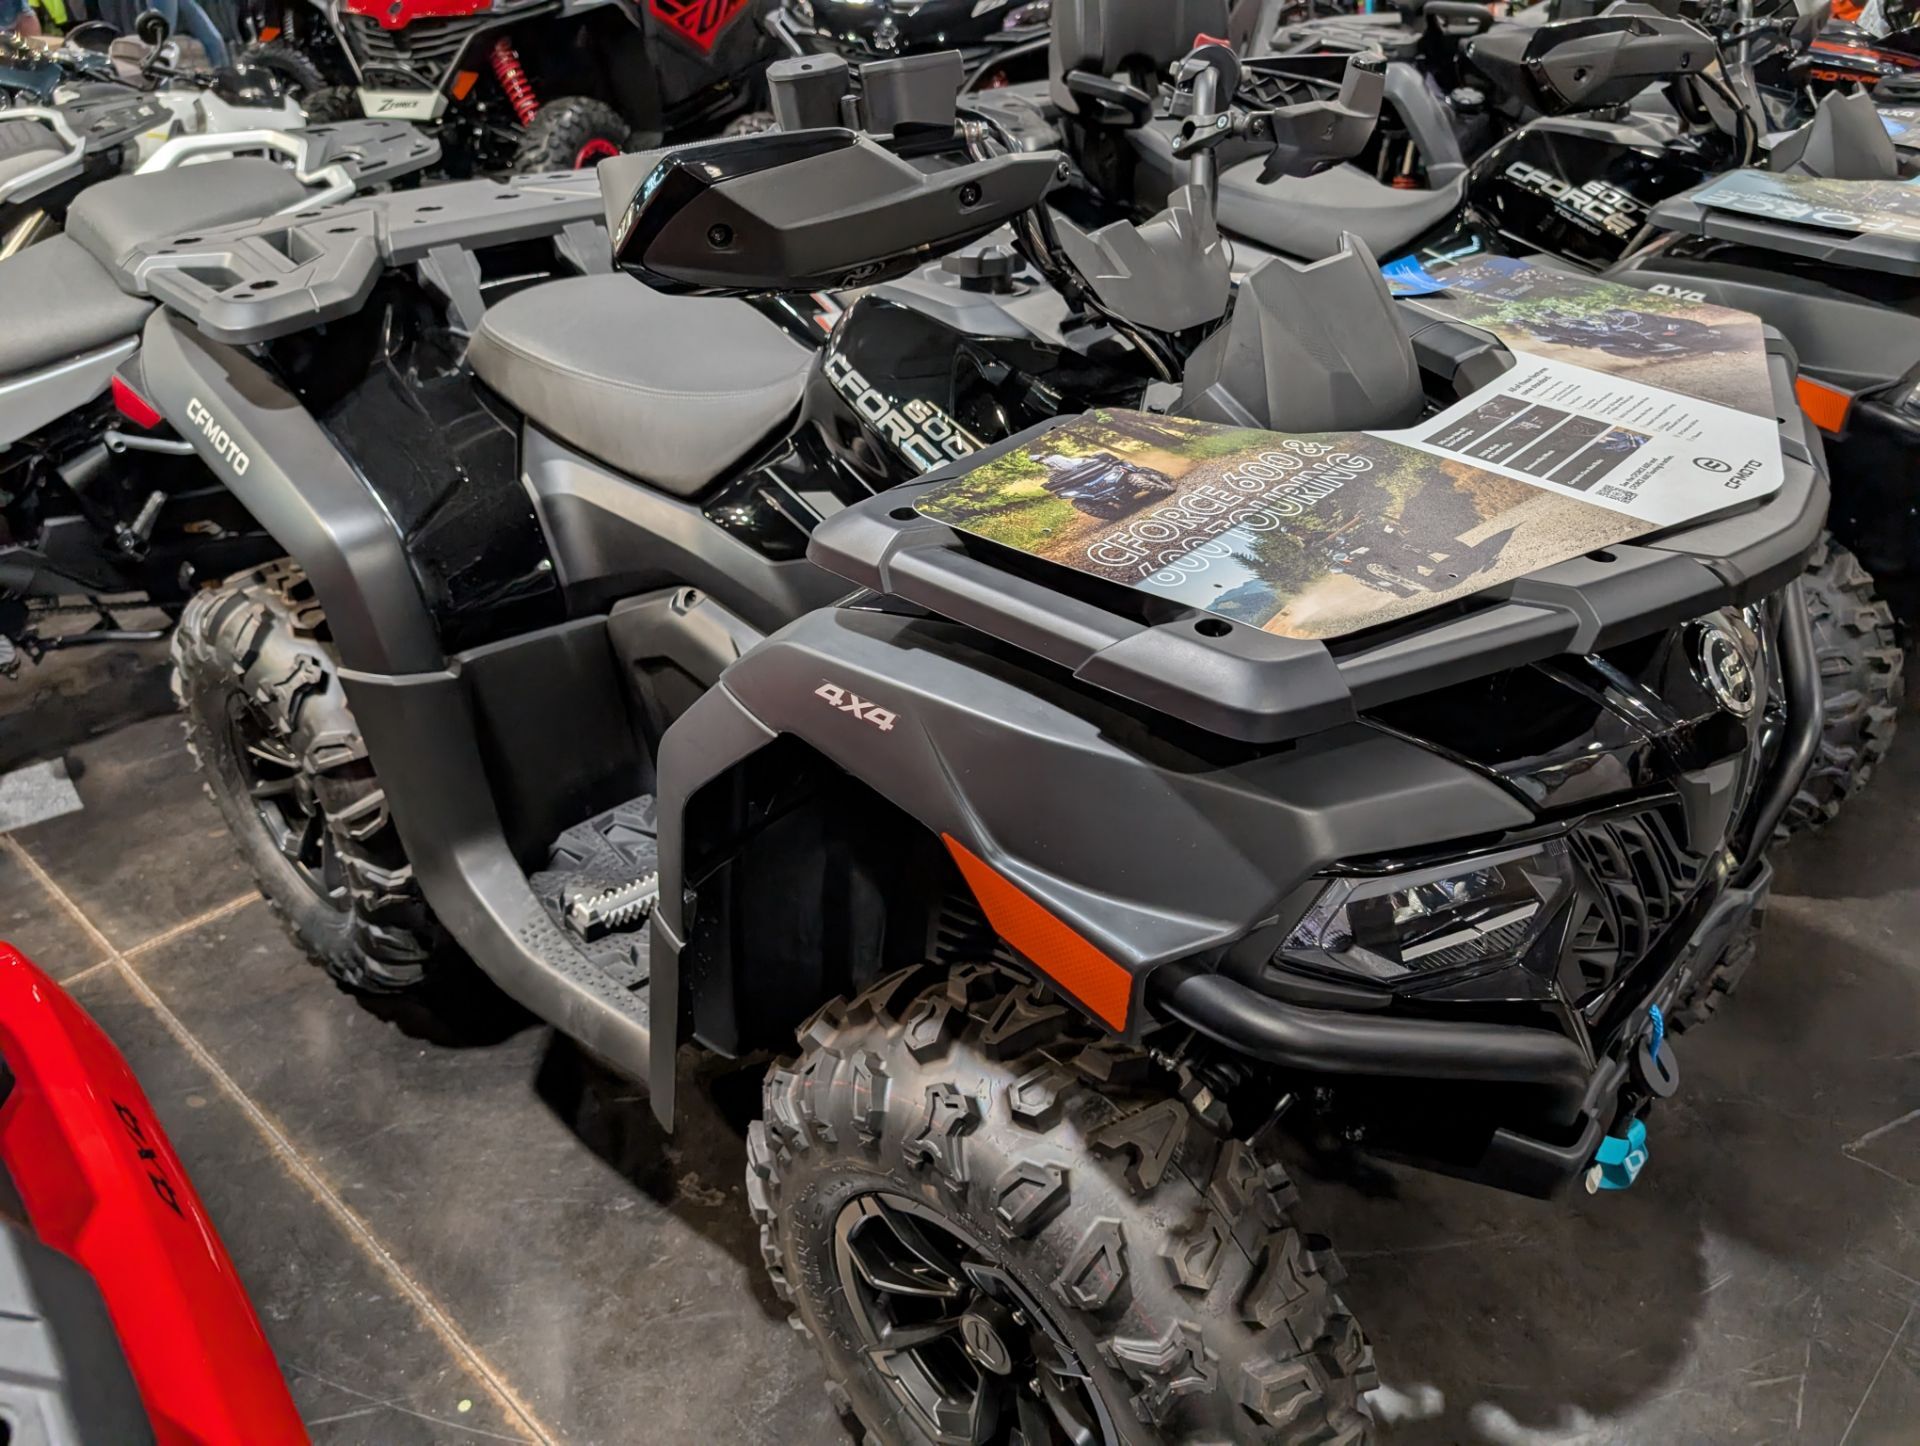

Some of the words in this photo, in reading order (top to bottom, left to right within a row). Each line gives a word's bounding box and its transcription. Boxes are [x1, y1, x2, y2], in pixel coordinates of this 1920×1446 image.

[1505, 161, 1638, 235] CFORCE
[186, 397, 250, 476] CFMOTO
[1724, 459, 1763, 489] CFMOTO
[1087, 485, 1244, 567] CFORCE
[1222, 452, 1303, 493] 600
[1282, 439, 1334, 457] &
[1138, 536, 1233, 587] 600
[1204, 453, 1374, 542] TOURING
